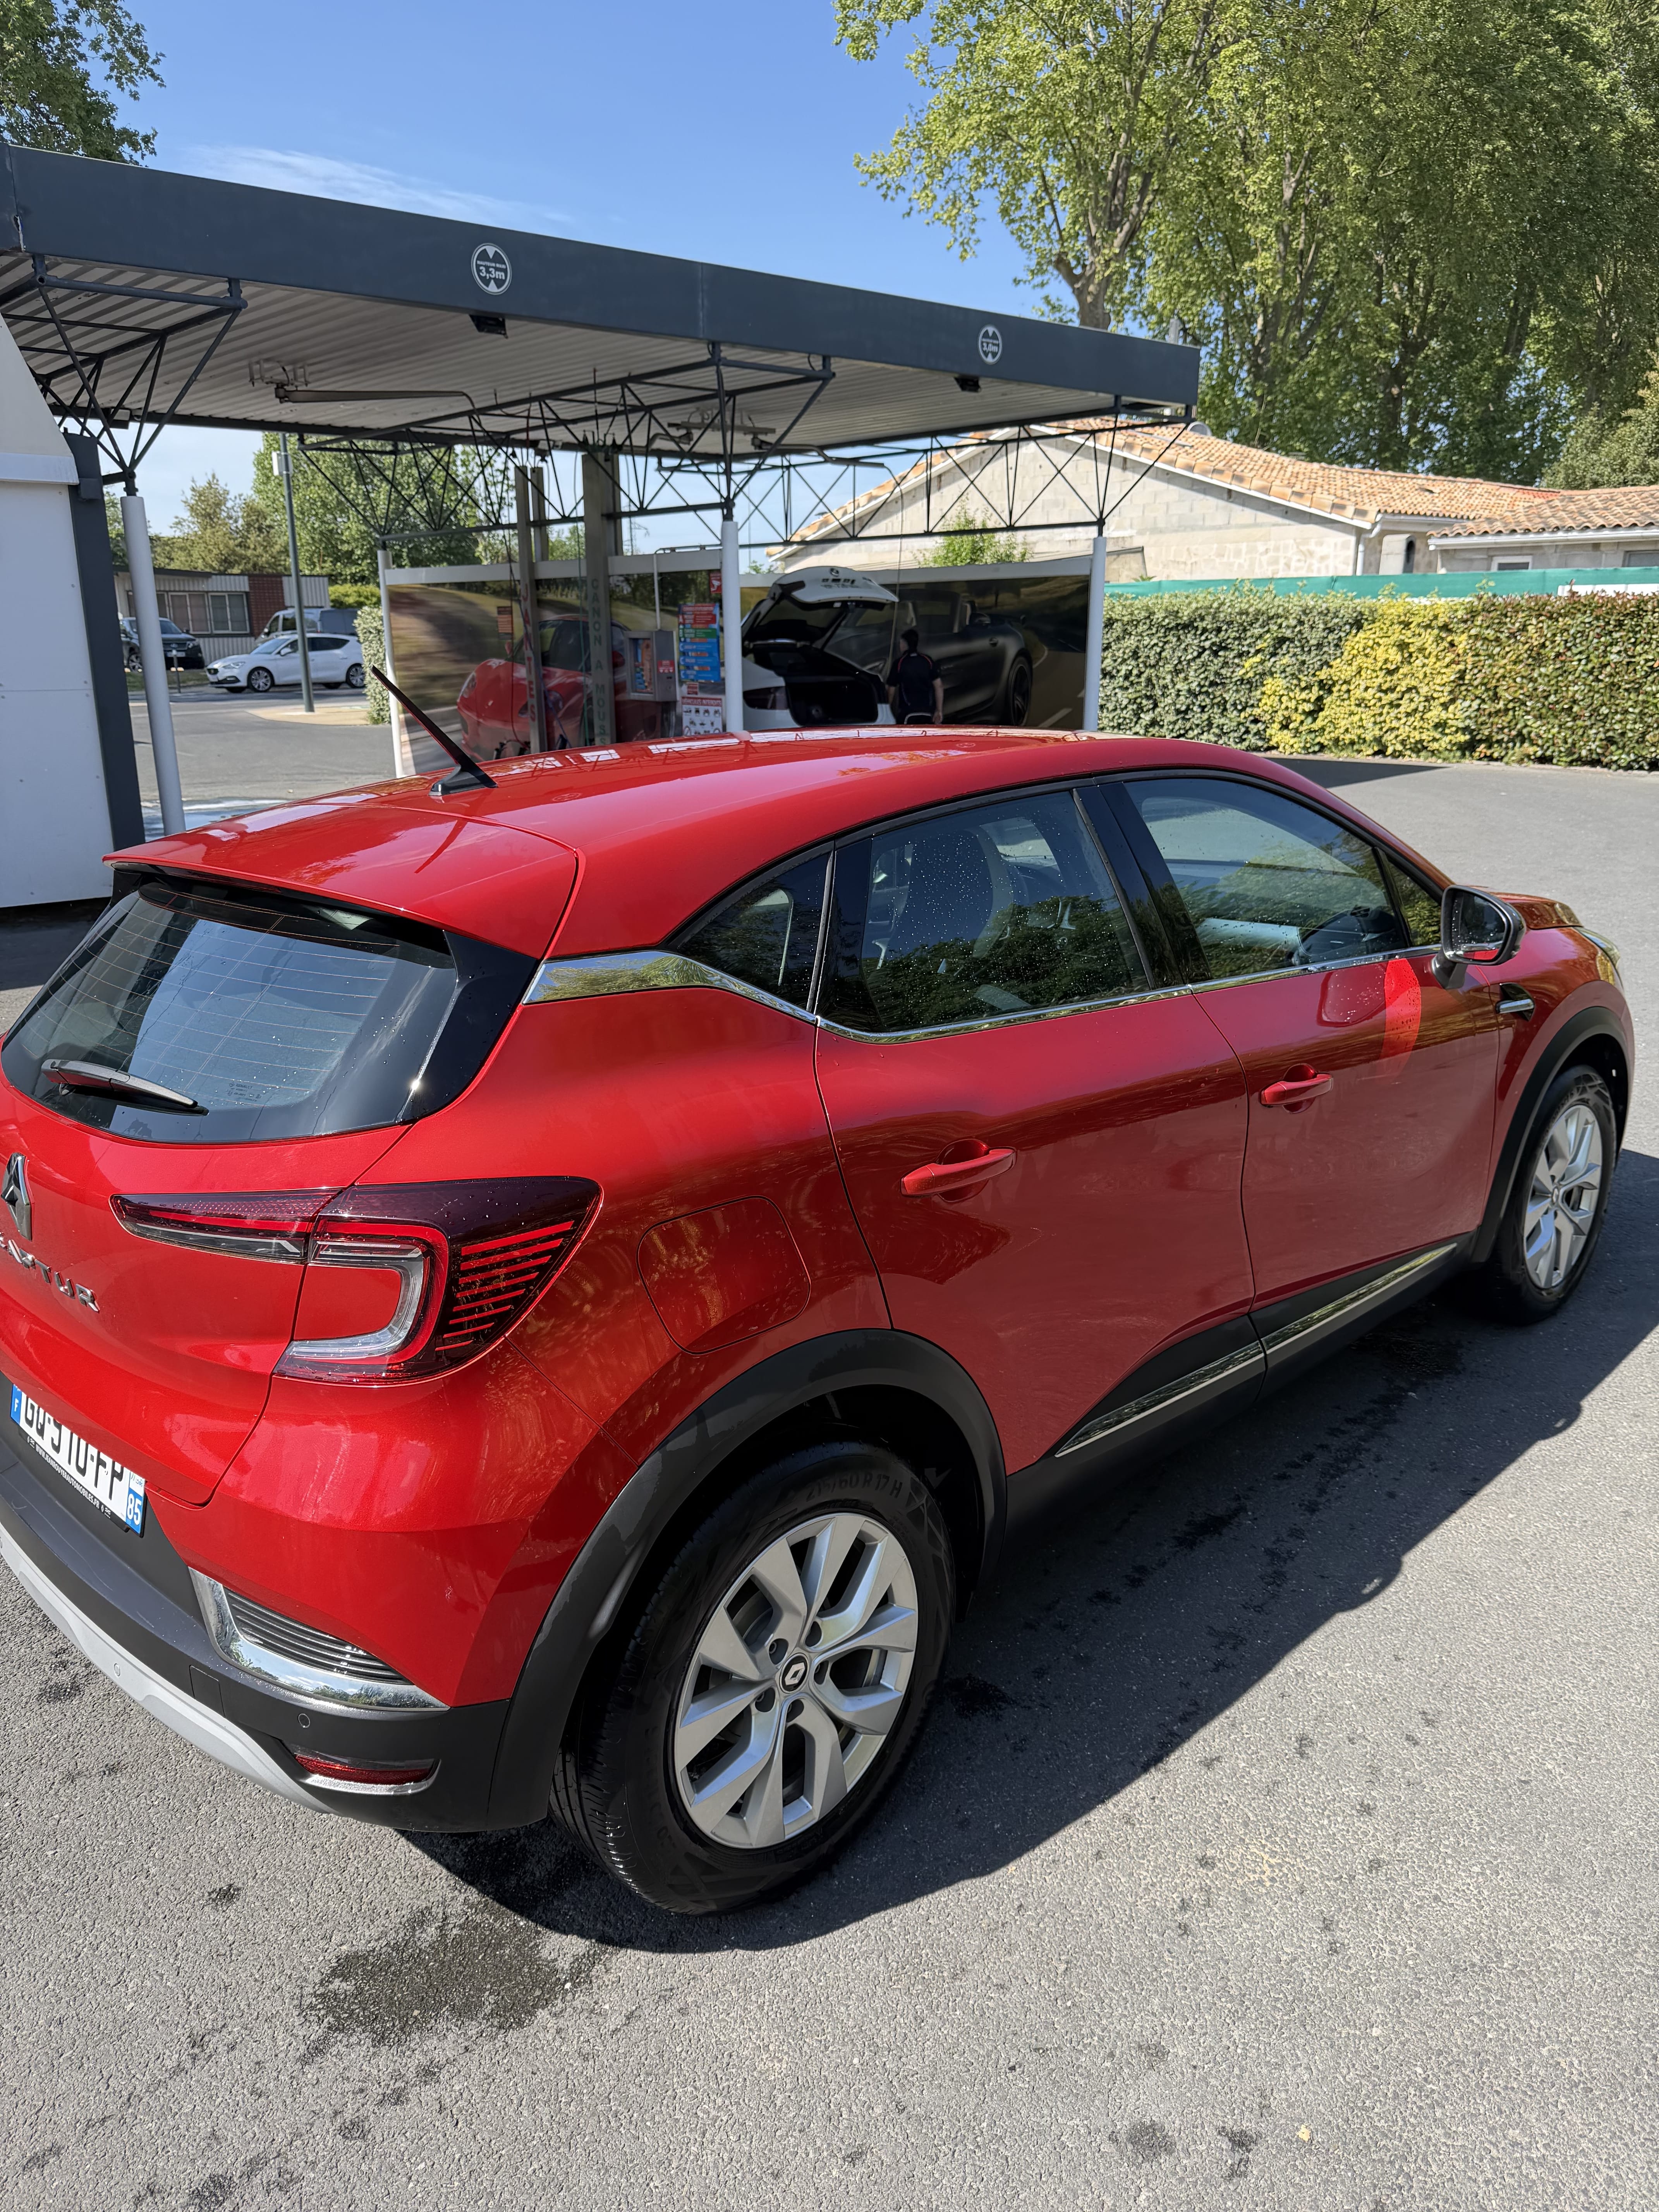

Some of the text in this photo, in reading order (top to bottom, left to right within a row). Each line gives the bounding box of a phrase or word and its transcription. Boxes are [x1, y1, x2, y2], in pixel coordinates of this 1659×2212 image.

[479, 266, 505, 280] 3,3m
[591, 579, 602, 646] CANON
[521, 584, 536, 722] JANTES
[14, 1398, 19, 1412] F
[127, 1493, 142, 1525] 85
